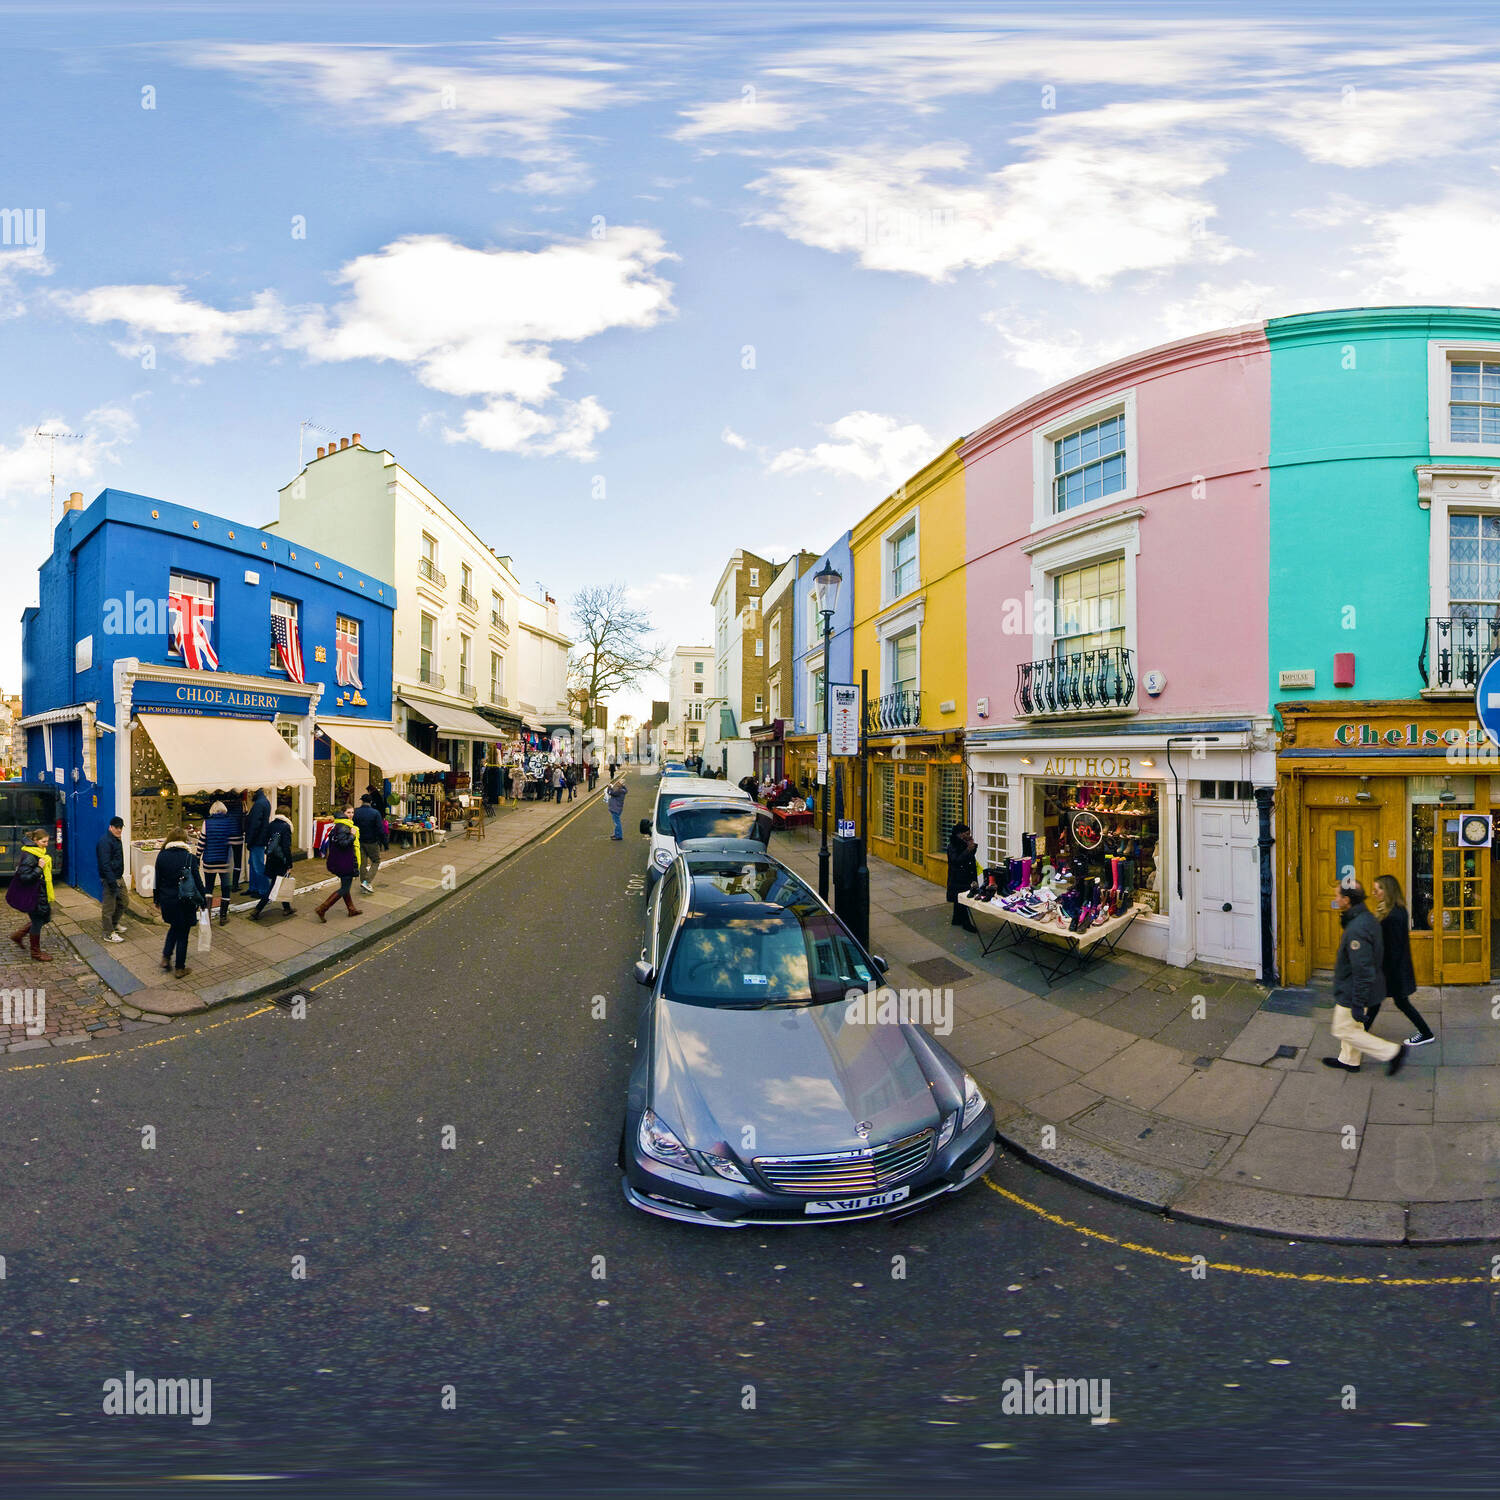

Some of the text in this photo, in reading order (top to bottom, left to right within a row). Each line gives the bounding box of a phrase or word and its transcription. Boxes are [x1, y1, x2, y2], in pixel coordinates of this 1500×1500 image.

[176, 687, 280, 709] CHLOE ALBERRY
[147, 706, 193, 715] PORTOBELLO
[1334, 723, 1487, 747] Chelsea
[1044, 757, 1132, 777] AUTHOR
